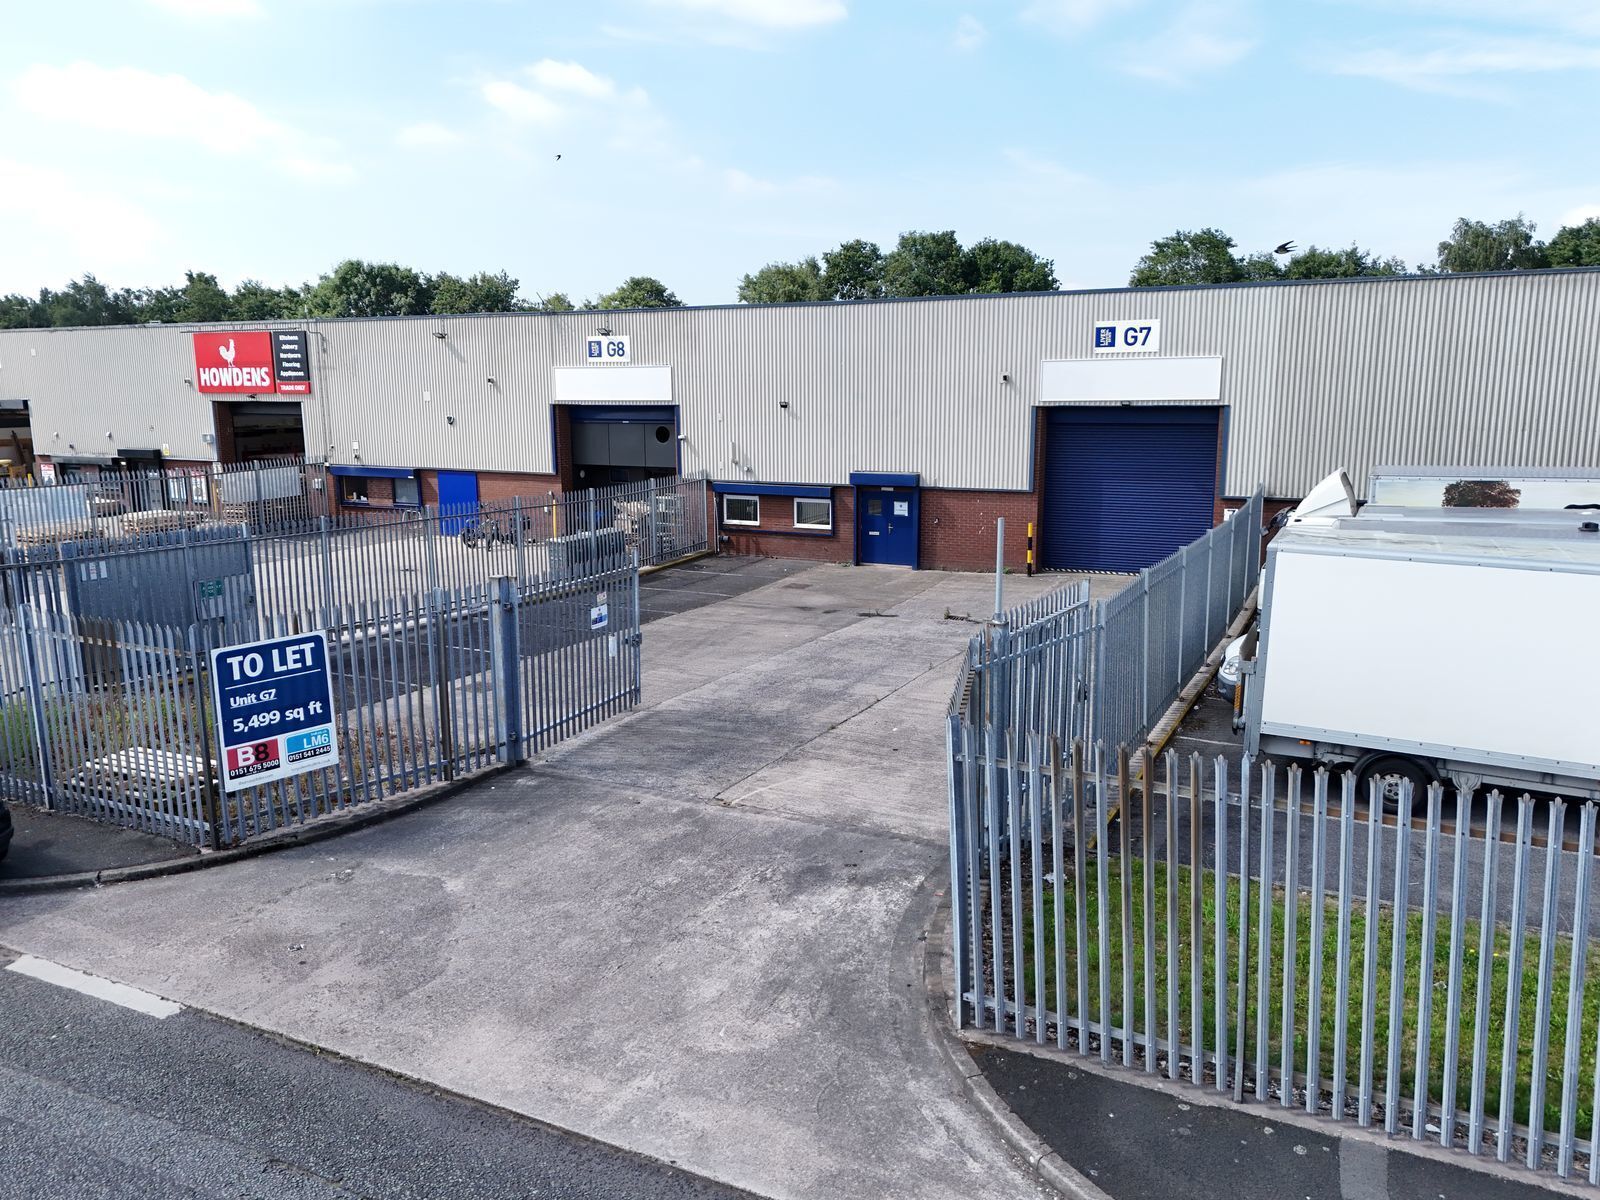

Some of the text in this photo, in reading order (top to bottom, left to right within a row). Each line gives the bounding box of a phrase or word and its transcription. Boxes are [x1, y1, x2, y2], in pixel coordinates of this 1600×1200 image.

[1124, 326, 1152, 347] G7
[607, 341, 625, 357] G8
[199, 367, 270, 386] HOWDENS
[226, 642, 315, 681] TO LET
[230, 689, 277, 708] Unit G7
[233, 700, 323, 733] 5,499 sq ft
[303, 733, 329, 749] LM6
[237, 743, 270, 767] B8
[289, 746, 331, 761] 0151 541 2445
[230, 766, 248, 777] 0151
[249, 763, 262, 772] 675
[262, 759, 279, 769] 5000
